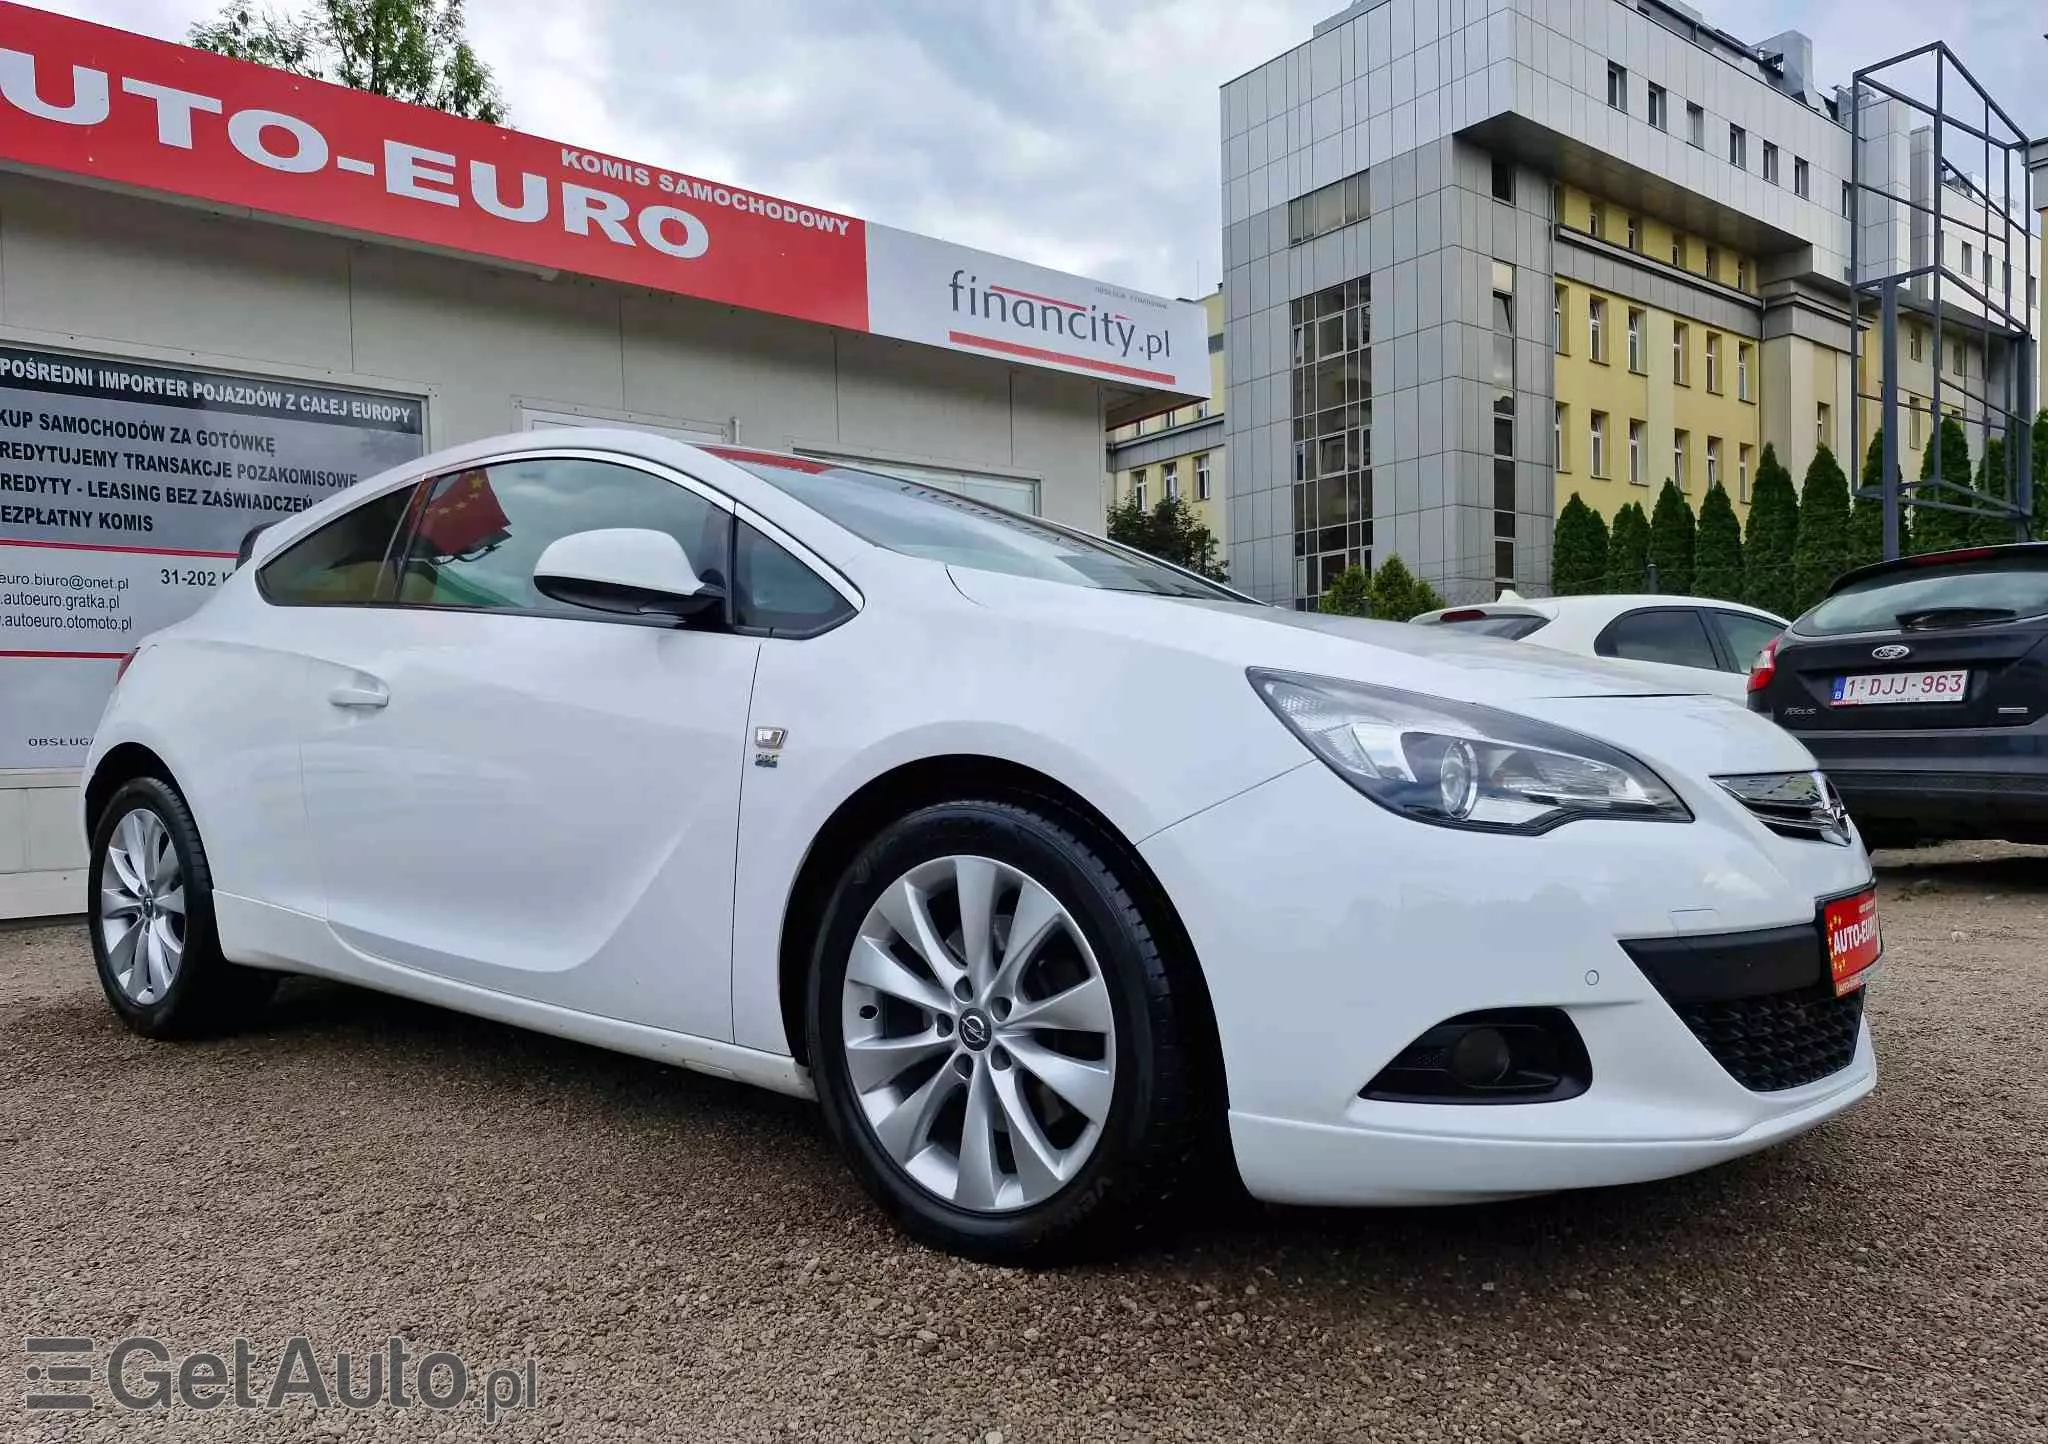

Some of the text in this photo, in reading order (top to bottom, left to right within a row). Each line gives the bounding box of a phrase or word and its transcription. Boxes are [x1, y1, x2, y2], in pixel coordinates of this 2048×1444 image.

[561, 147, 850, 237] KOMIS SAMOCHODOWY
[948, 269, 1171, 360] financity.pl
[0, 357, 411, 424] POŚREDNI IMPORTER POJAZDÓW Z CAŁEJ EUROPY
[39, 413, 165, 442] SAMOCHODÓW
[170, 427, 191, 445] ZA
[197, 430, 276, 457] GOTÓWKĘ
[124, 453, 232, 478] TRANSAKCJE
[88, 481, 161, 502] LEASING
[166, 487, 197, 505] BEZ
[99, 512, 153, 532] KOMIS
[161, 568, 216, 587] 31-202
[0, 613, 132, 632] .autoeuro.otomoto.pl
[1848, 674, 1963, 697] 1-DJJ-963
